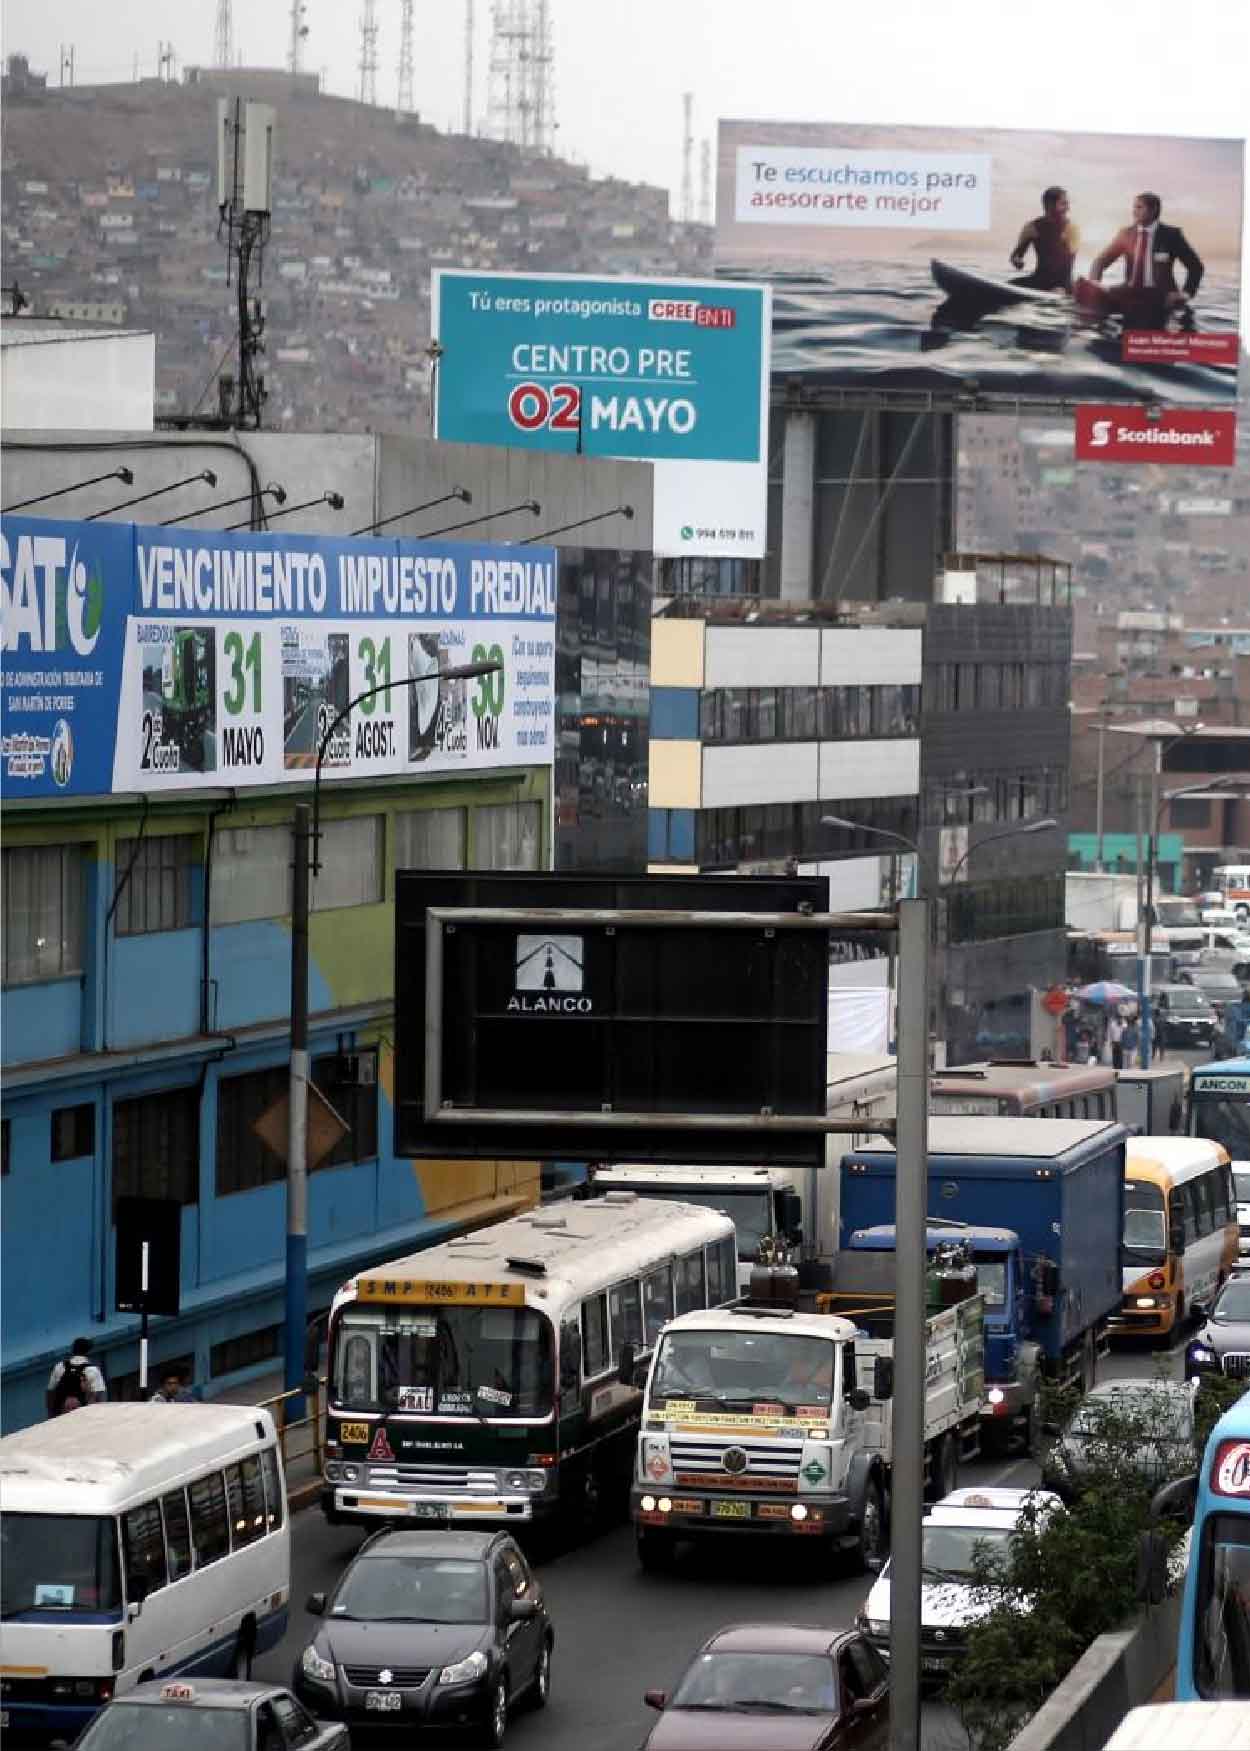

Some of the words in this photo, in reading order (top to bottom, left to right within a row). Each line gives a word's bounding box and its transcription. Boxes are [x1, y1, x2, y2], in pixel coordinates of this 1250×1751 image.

[752, 162, 777, 182] Te
[784, 163, 919, 187] escuchamos
[925, 170, 977, 191] para
[750, 189, 868, 211] asesorarte
[876, 192, 942, 217] mejor
[468, 291, 491, 310] Tú
[495, 297, 530, 312] eres
[534, 298, 642, 320] protagonista
[652, 305, 695, 320] CREE
[512, 345, 630, 375] CENTRO
[638, 349, 692, 377] PRE
[509, 383, 582, 432] 02
[591, 396, 696, 433] MAYO
[1117, 427, 1214, 445] Scotiabank
[137, 545, 326, 612] VENCIMIENTO
[340, 554, 456, 614] IMPUESTO
[472, 560, 556, 615] PREDIAL
[223, 631, 262, 716] 31
[358, 636, 391, 715] 31
[471, 643, 504, 717] 30
[223, 726, 264, 767] MAYO
[506, 996, 593, 1014] ALANCO
